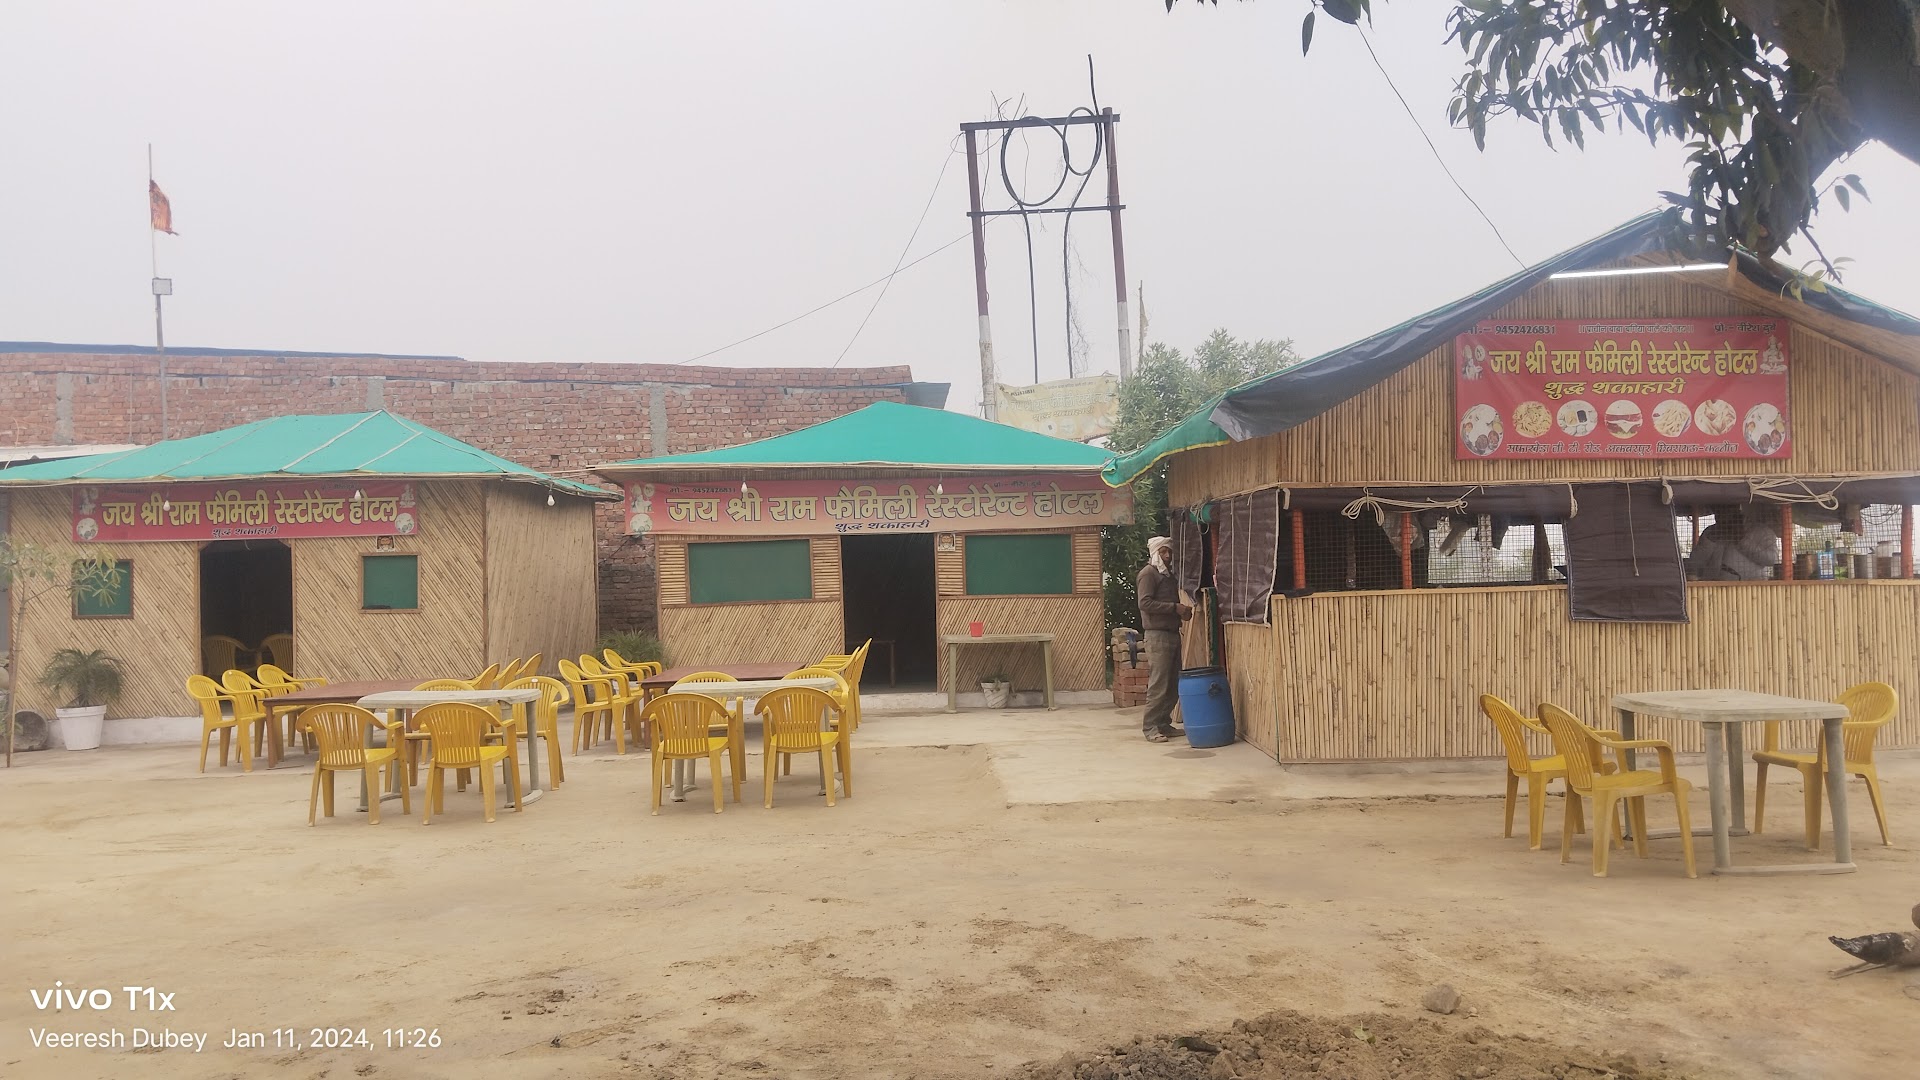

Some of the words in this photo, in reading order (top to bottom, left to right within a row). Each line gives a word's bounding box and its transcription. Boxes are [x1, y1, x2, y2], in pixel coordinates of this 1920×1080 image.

[1495, 325, 1556, 335] 9452426831
[1489, 350, 1521, 374] जय
[1525, 340, 1548, 374] श्री
[1550, 350, 1581, 374] राम
[1585, 339, 1643, 375] फैमिली
[1646, 340, 1711, 375] रेस्टोरेन्ट
[1714, 339, 1758, 376] होटल
[1543, 381, 1587, 399] शुद्ध
[1592, 377, 1687, 395] शकाहारी
[101, 502, 136, 526] जय
[140, 492, 164, 526] श्री
[168, 501, 201, 526] राम
[205, 489, 270, 526] फैमिली
[274, 489, 345, 524] रेस्टोरेन्ट
[349, 488, 399, 525] होटल
[665, 498, 720, 522] जय
[725, 487, 763, 522] श्री
[768, 496, 818, 521] राम
[823, 484, 919, 520] फैमिली
[925, 483, 1029, 519] रेस्टोरेन्ट
[1032, 482, 1106, 518] होटल
[835, 522, 864, 533] शुद्ध
